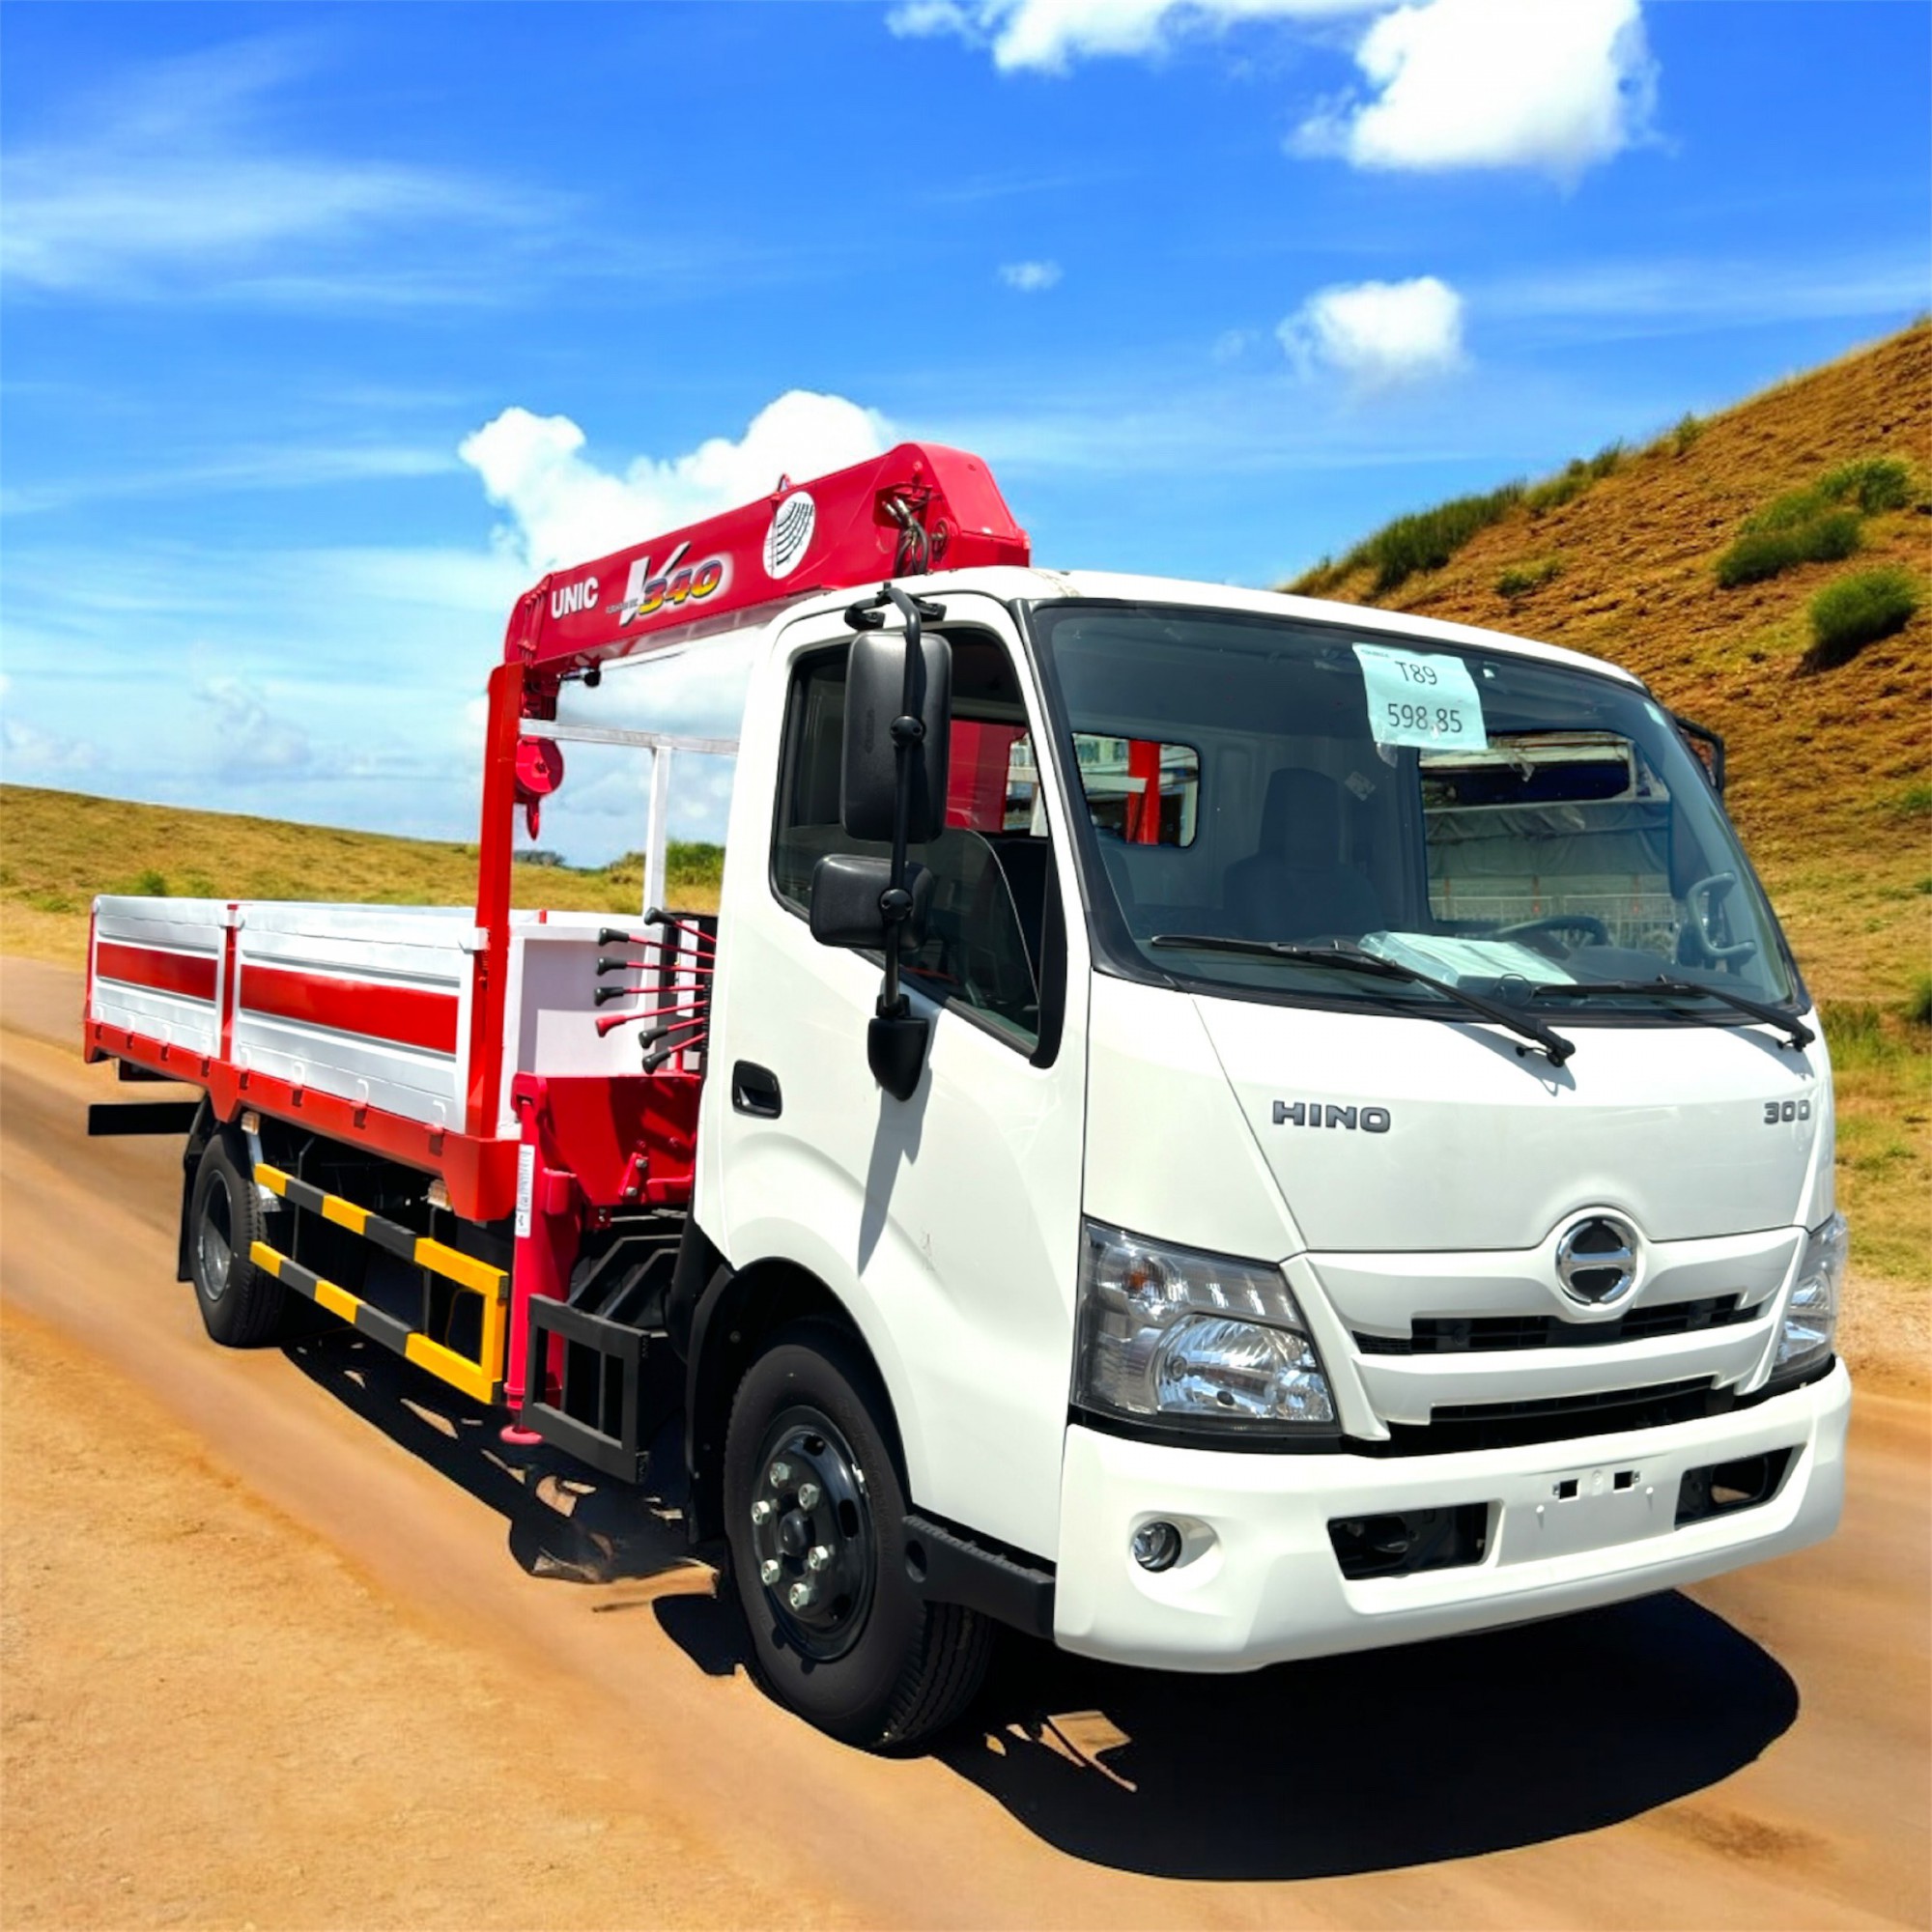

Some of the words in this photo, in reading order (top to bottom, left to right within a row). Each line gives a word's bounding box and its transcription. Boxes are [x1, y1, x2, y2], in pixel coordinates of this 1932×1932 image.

[552, 577, 599, 620] UNIC
[1395, 661, 1437, 685] T89
[1272, 1099, 1391, 1133] HINO
[1763, 1099, 1810, 1124] 300
